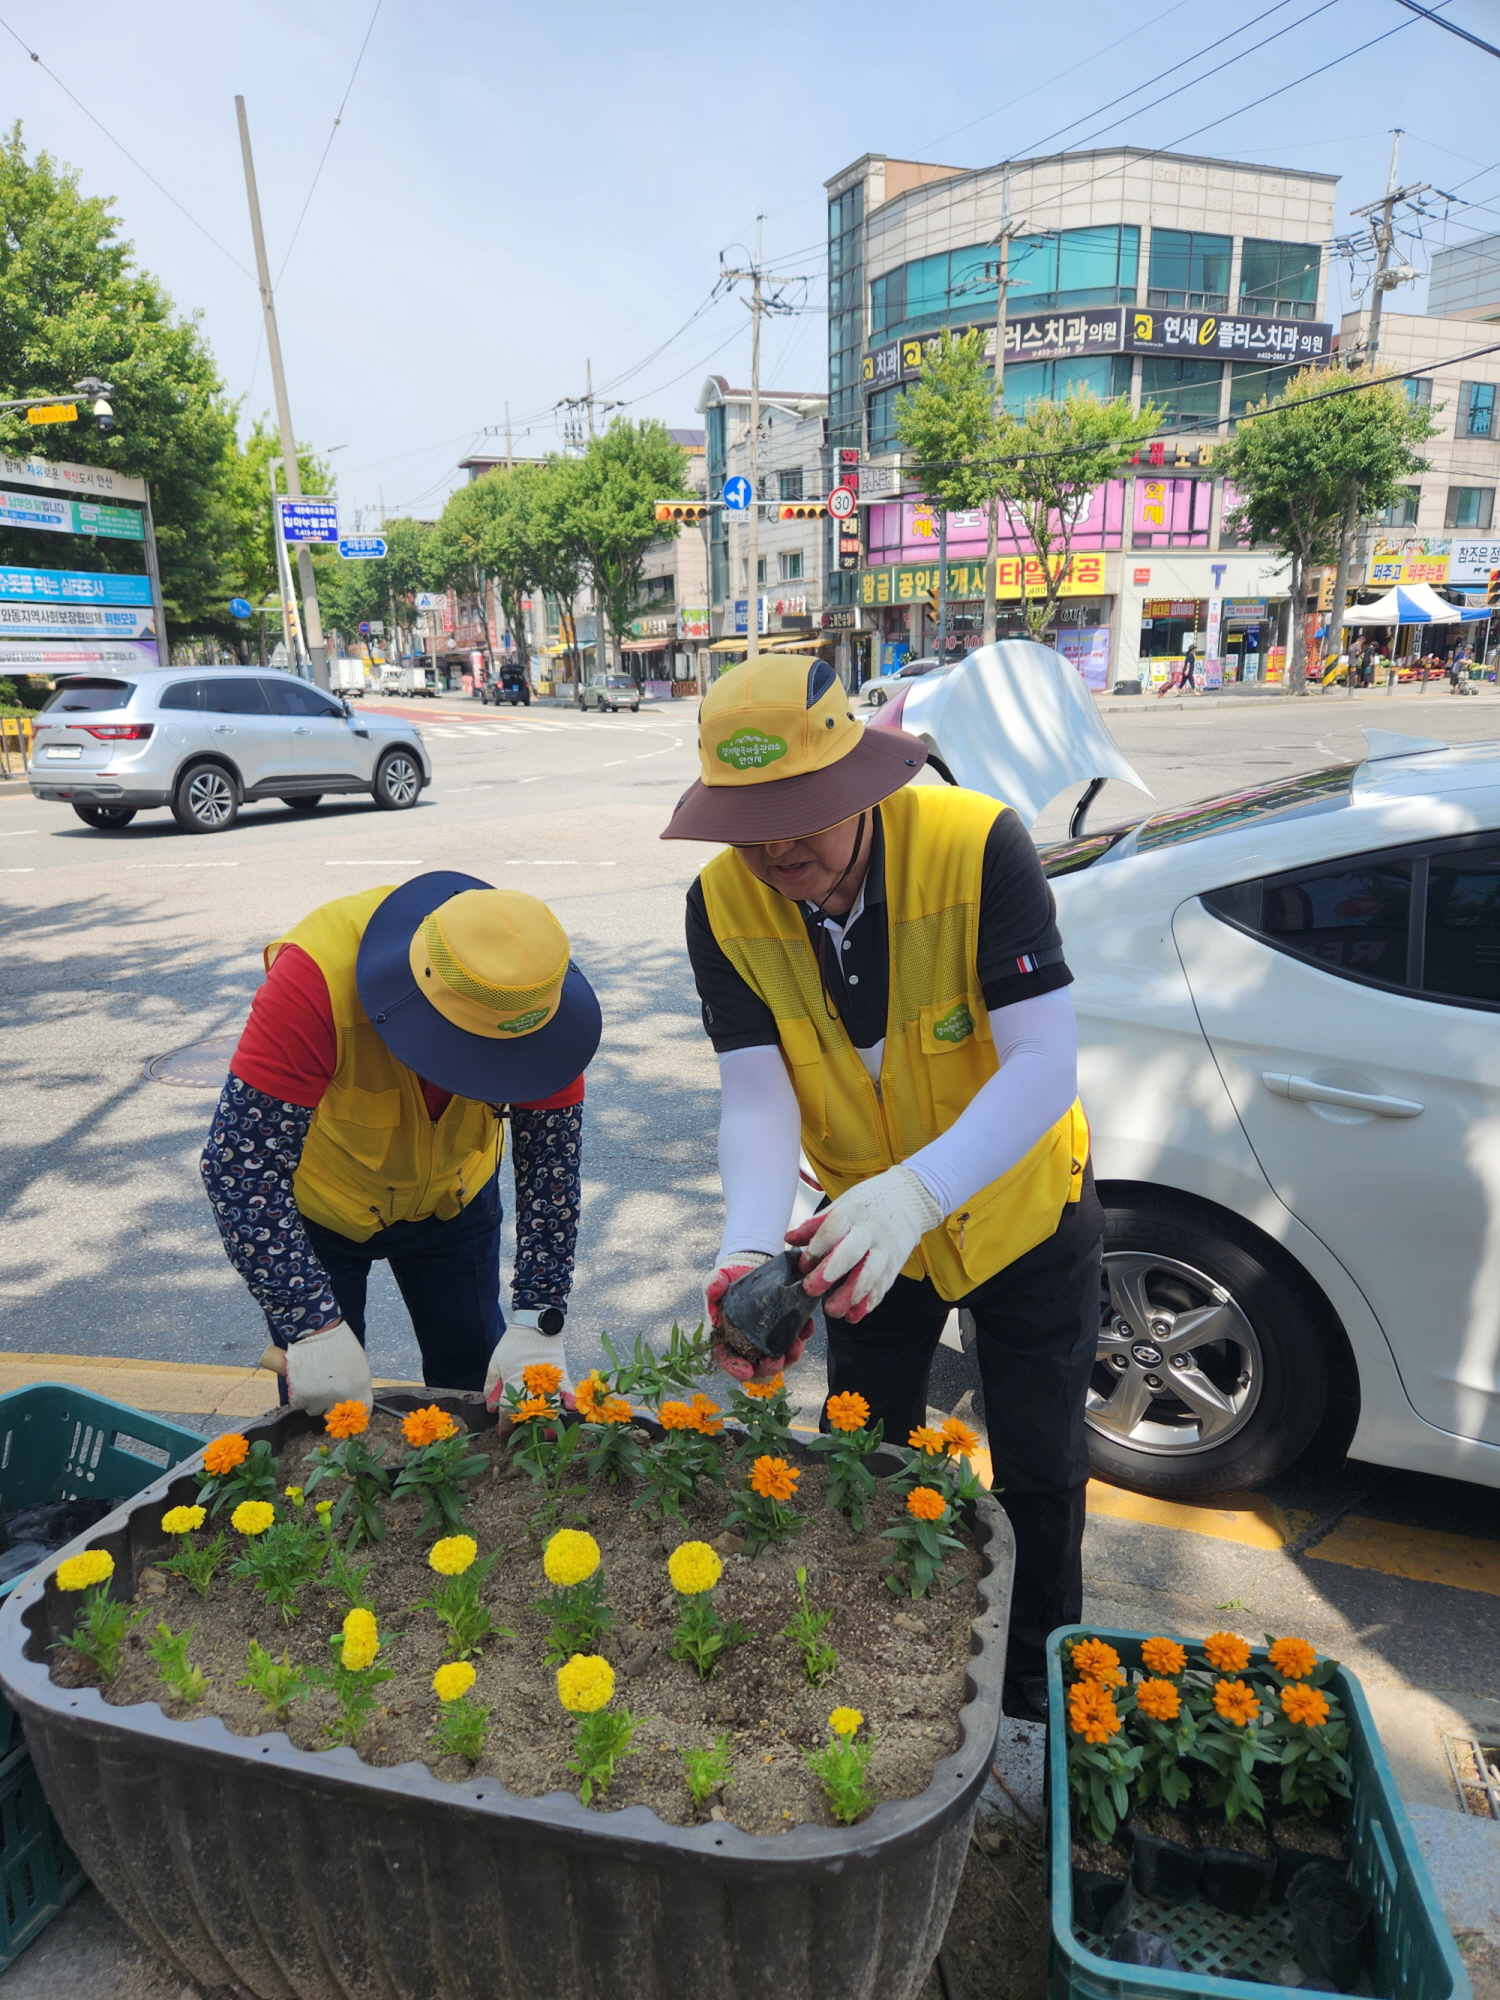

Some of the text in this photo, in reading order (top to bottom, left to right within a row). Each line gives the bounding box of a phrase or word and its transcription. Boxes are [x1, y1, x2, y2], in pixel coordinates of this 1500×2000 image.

[876, 346, 897, 376] 치과
[26, 464, 60, 480] 자유로운
[63, 469, 94, 487] 혁신도시
[96, 475, 113, 490] 안산
[834, 496, 850, 510] 30
[283, 516, 337, 529] 임마누엘교회
[723, 512, 751, 522] 동시신호
[844, 557, 855, 568] 2F
[1458, 546, 1488, 564] 참조은
[1000, 558, 1101, 586] 타일시공
[1373, 563, 1446, 582] 퍼주고 퍼주는집
[61, 578, 104, 598] 실태조사
[862, 573, 890, 604] 황금
[1, 608, 137, 626] 와동지역사회보장협의체 위원모집
[1152, 603, 1170, 615] 휴대폰
[721, 742, 781, 757] 경기행복마을관리소
[738, 755, 762, 765] 안산시
